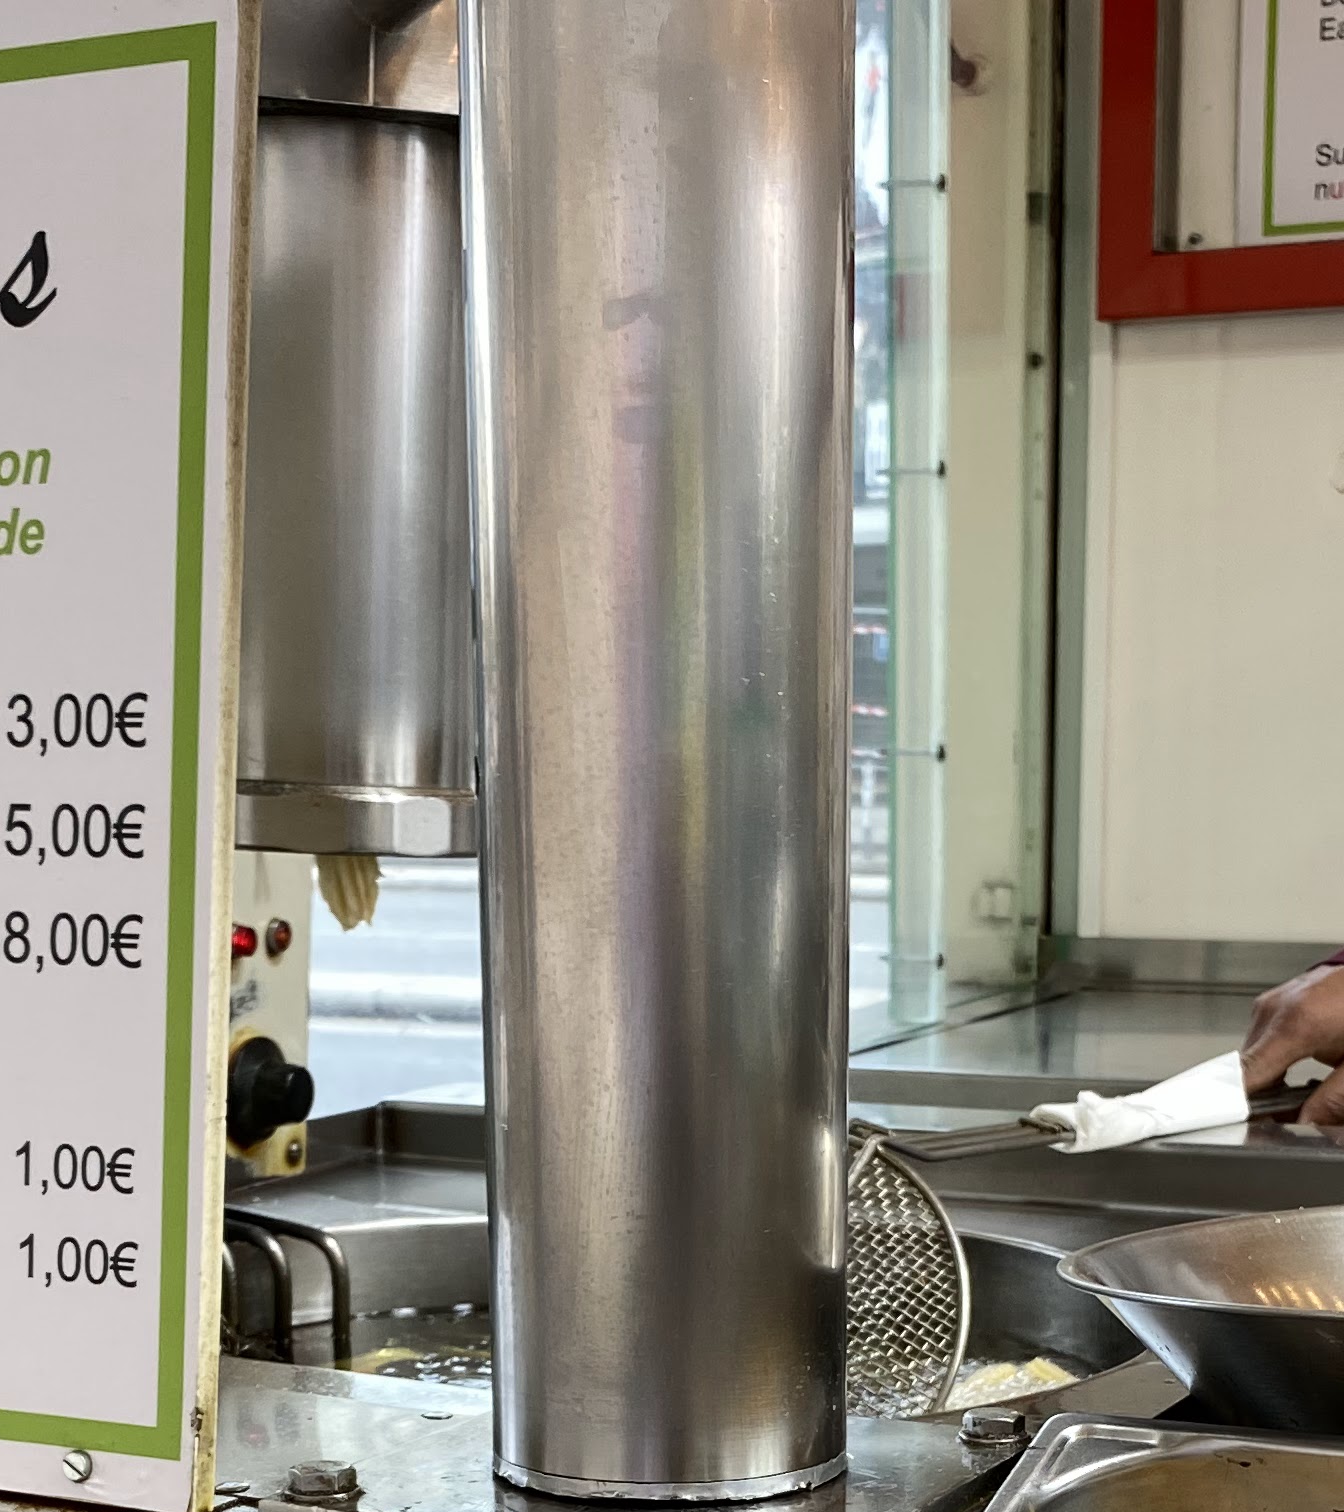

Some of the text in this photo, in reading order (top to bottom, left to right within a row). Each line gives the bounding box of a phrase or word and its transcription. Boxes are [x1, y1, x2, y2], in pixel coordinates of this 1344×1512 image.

[5, 692, 149, 757] 3,00€
[3, 803, 147, 866] 5,00€
[2, 910, 144, 974] 8,00€
[14, 1140, 136, 1196] 1,00€
[18, 1233, 139, 1289] 1,00€
